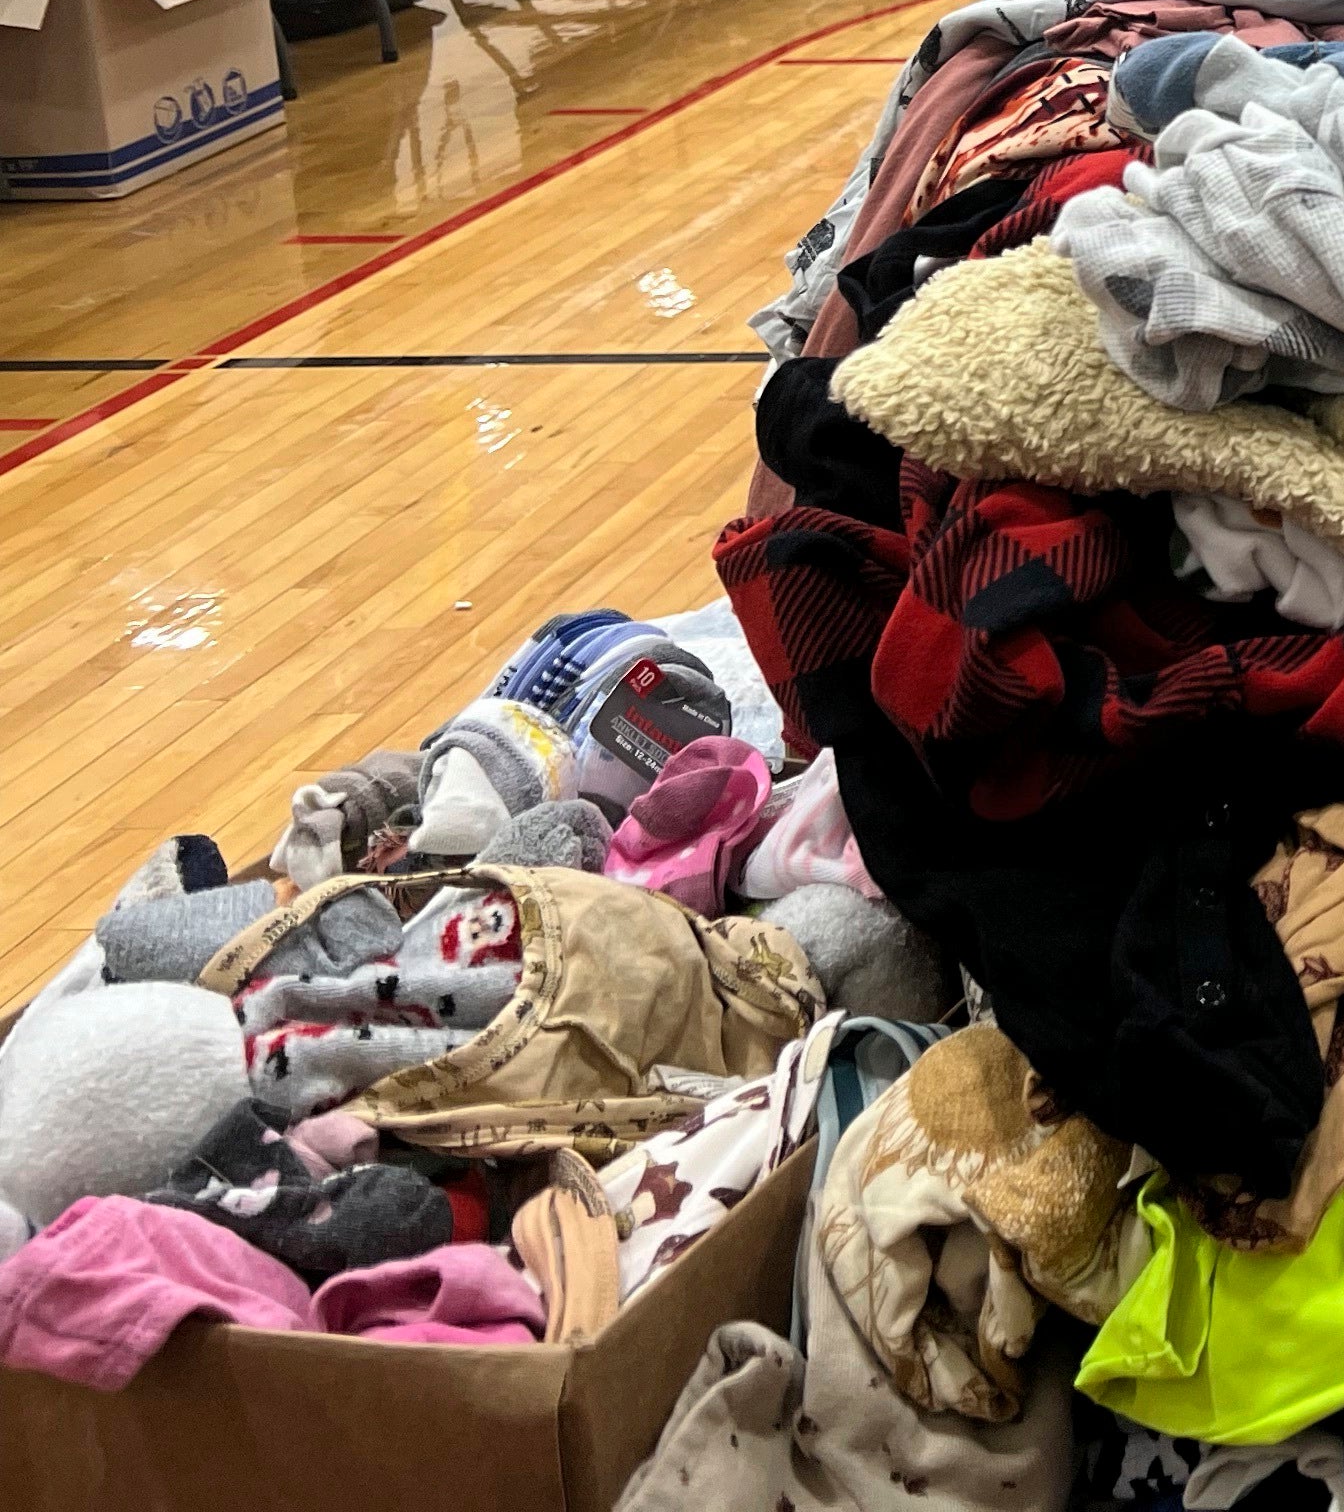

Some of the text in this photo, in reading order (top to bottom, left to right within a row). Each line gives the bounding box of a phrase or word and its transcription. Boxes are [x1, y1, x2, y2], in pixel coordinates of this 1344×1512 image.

[636, 666, 656, 687] 10
[610, 716, 648, 748] ANKLET
[615, 734, 633, 753] Size:
